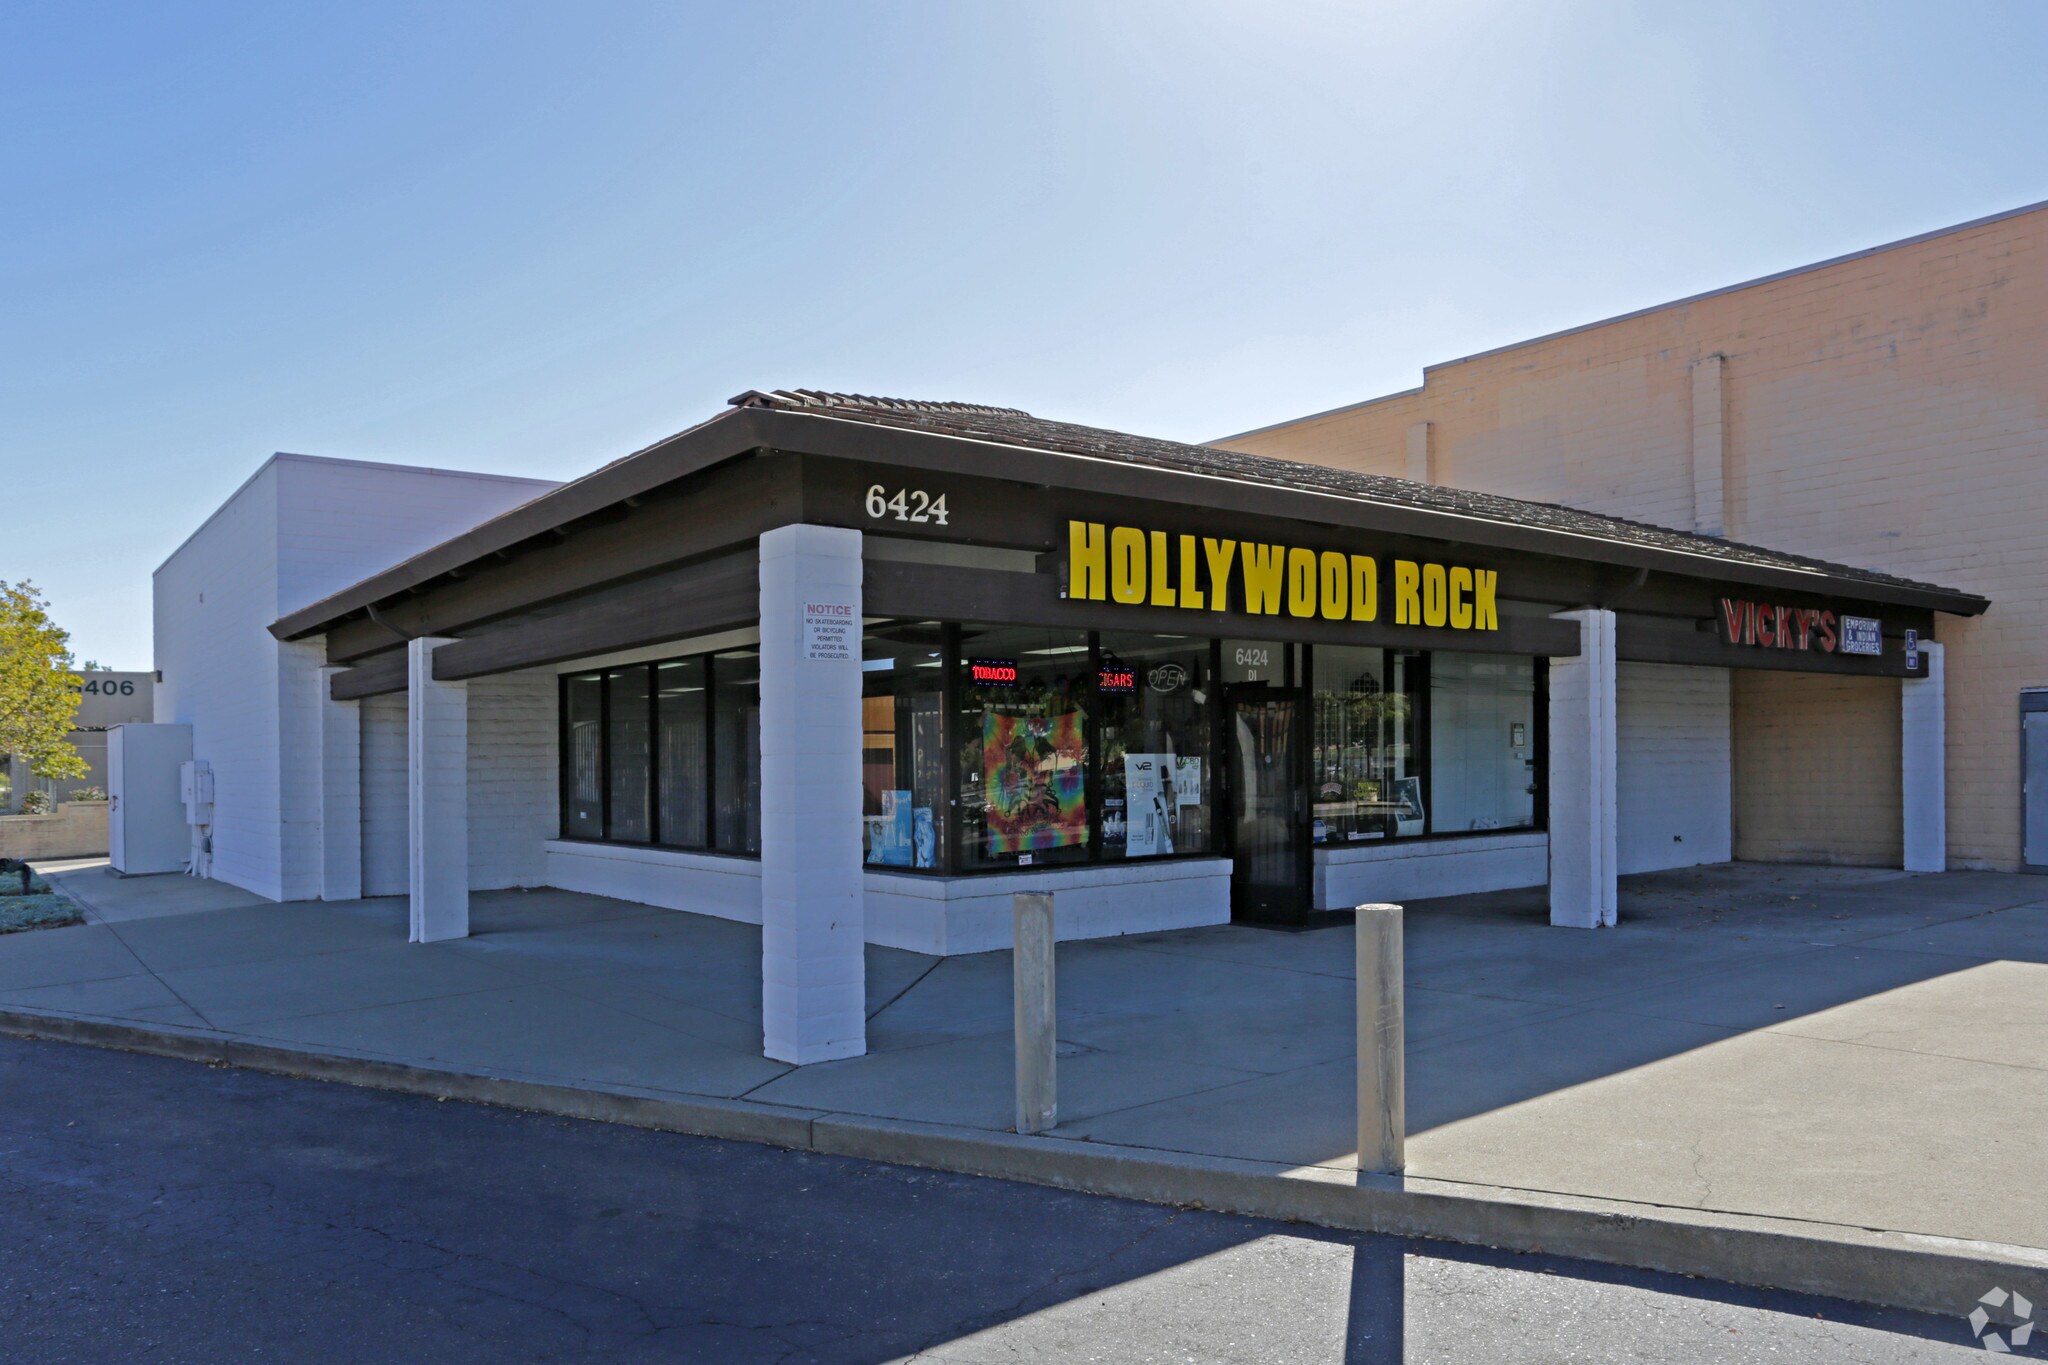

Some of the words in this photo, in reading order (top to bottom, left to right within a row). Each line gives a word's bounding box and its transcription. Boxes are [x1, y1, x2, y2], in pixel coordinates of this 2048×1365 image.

[866, 484, 949, 525] 6424
[1069, 520, 1377, 622] HOLLYWOOD
[1395, 559, 1498, 631] ROCK
[807, 604, 852, 615] NOTICE
[1722, 598, 1836, 653] VICKY'S
[1846, 618, 1878, 631] EMPORIUM
[1856, 631, 1876, 641] INDIAN
[1846, 640, 1880, 654] GROCERIES
[1235, 648, 1269, 666] 6424
[972, 666, 1016, 681] TOBACCO
[1099, 673, 1133, 687] CIGARS
[1148, 669, 1186, 686] OPEN
